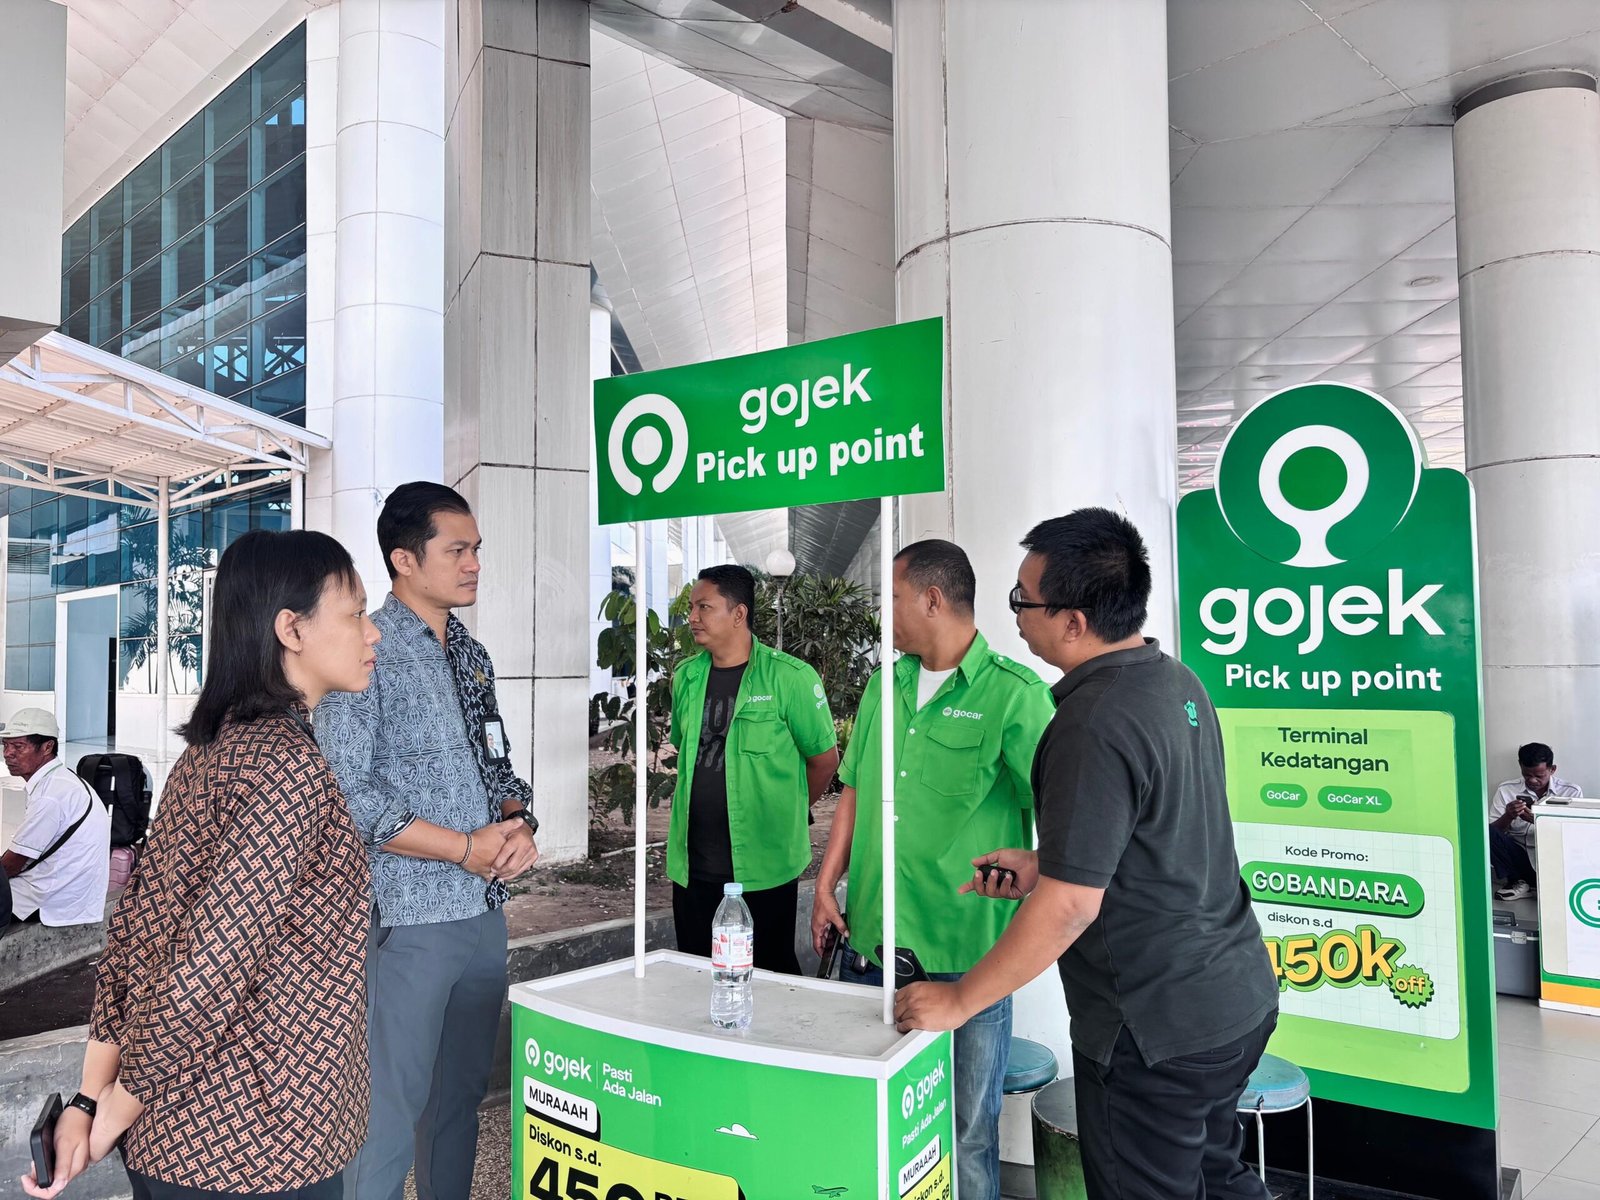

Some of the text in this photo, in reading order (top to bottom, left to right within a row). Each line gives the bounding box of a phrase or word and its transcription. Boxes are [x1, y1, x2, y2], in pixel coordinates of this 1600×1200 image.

[739, 363, 872, 434] gojek
[696, 423, 925, 483] Pick up point
[1199, 568, 1446, 655] gojek
[1225, 664, 1442, 697] Pick up point
[952, 709, 983, 720] gocar
[1278, 727, 1368, 745] Terminal
[1261, 752, 1389, 775] Kedatangan
[1266, 790, 1300, 801] GoCar
[1327, 793, 1382, 806] GoCar XL
[1285, 845, 1369, 862] Kode Promo:
[1252, 870, 1409, 905] GOBANDARA
[1267, 912, 1333, 928] diskon s.d
[1395, 975, 1426, 995] off
[543, 1050, 592, 1082] gojek
[603, 1062, 633, 1083] Pasti
[603, 1079, 662, 1107] Ada Jalan
[916, 1058, 945, 1109] gojek
[529, 1085, 588, 1121] MURAAAH
[902, 1121, 920, 1149] Pasti
[932, 1098, 947, 1120] Jalan
[529, 1124, 602, 1167] Diskon s.d.
[903, 1144, 937, 1185] MURAAAH
